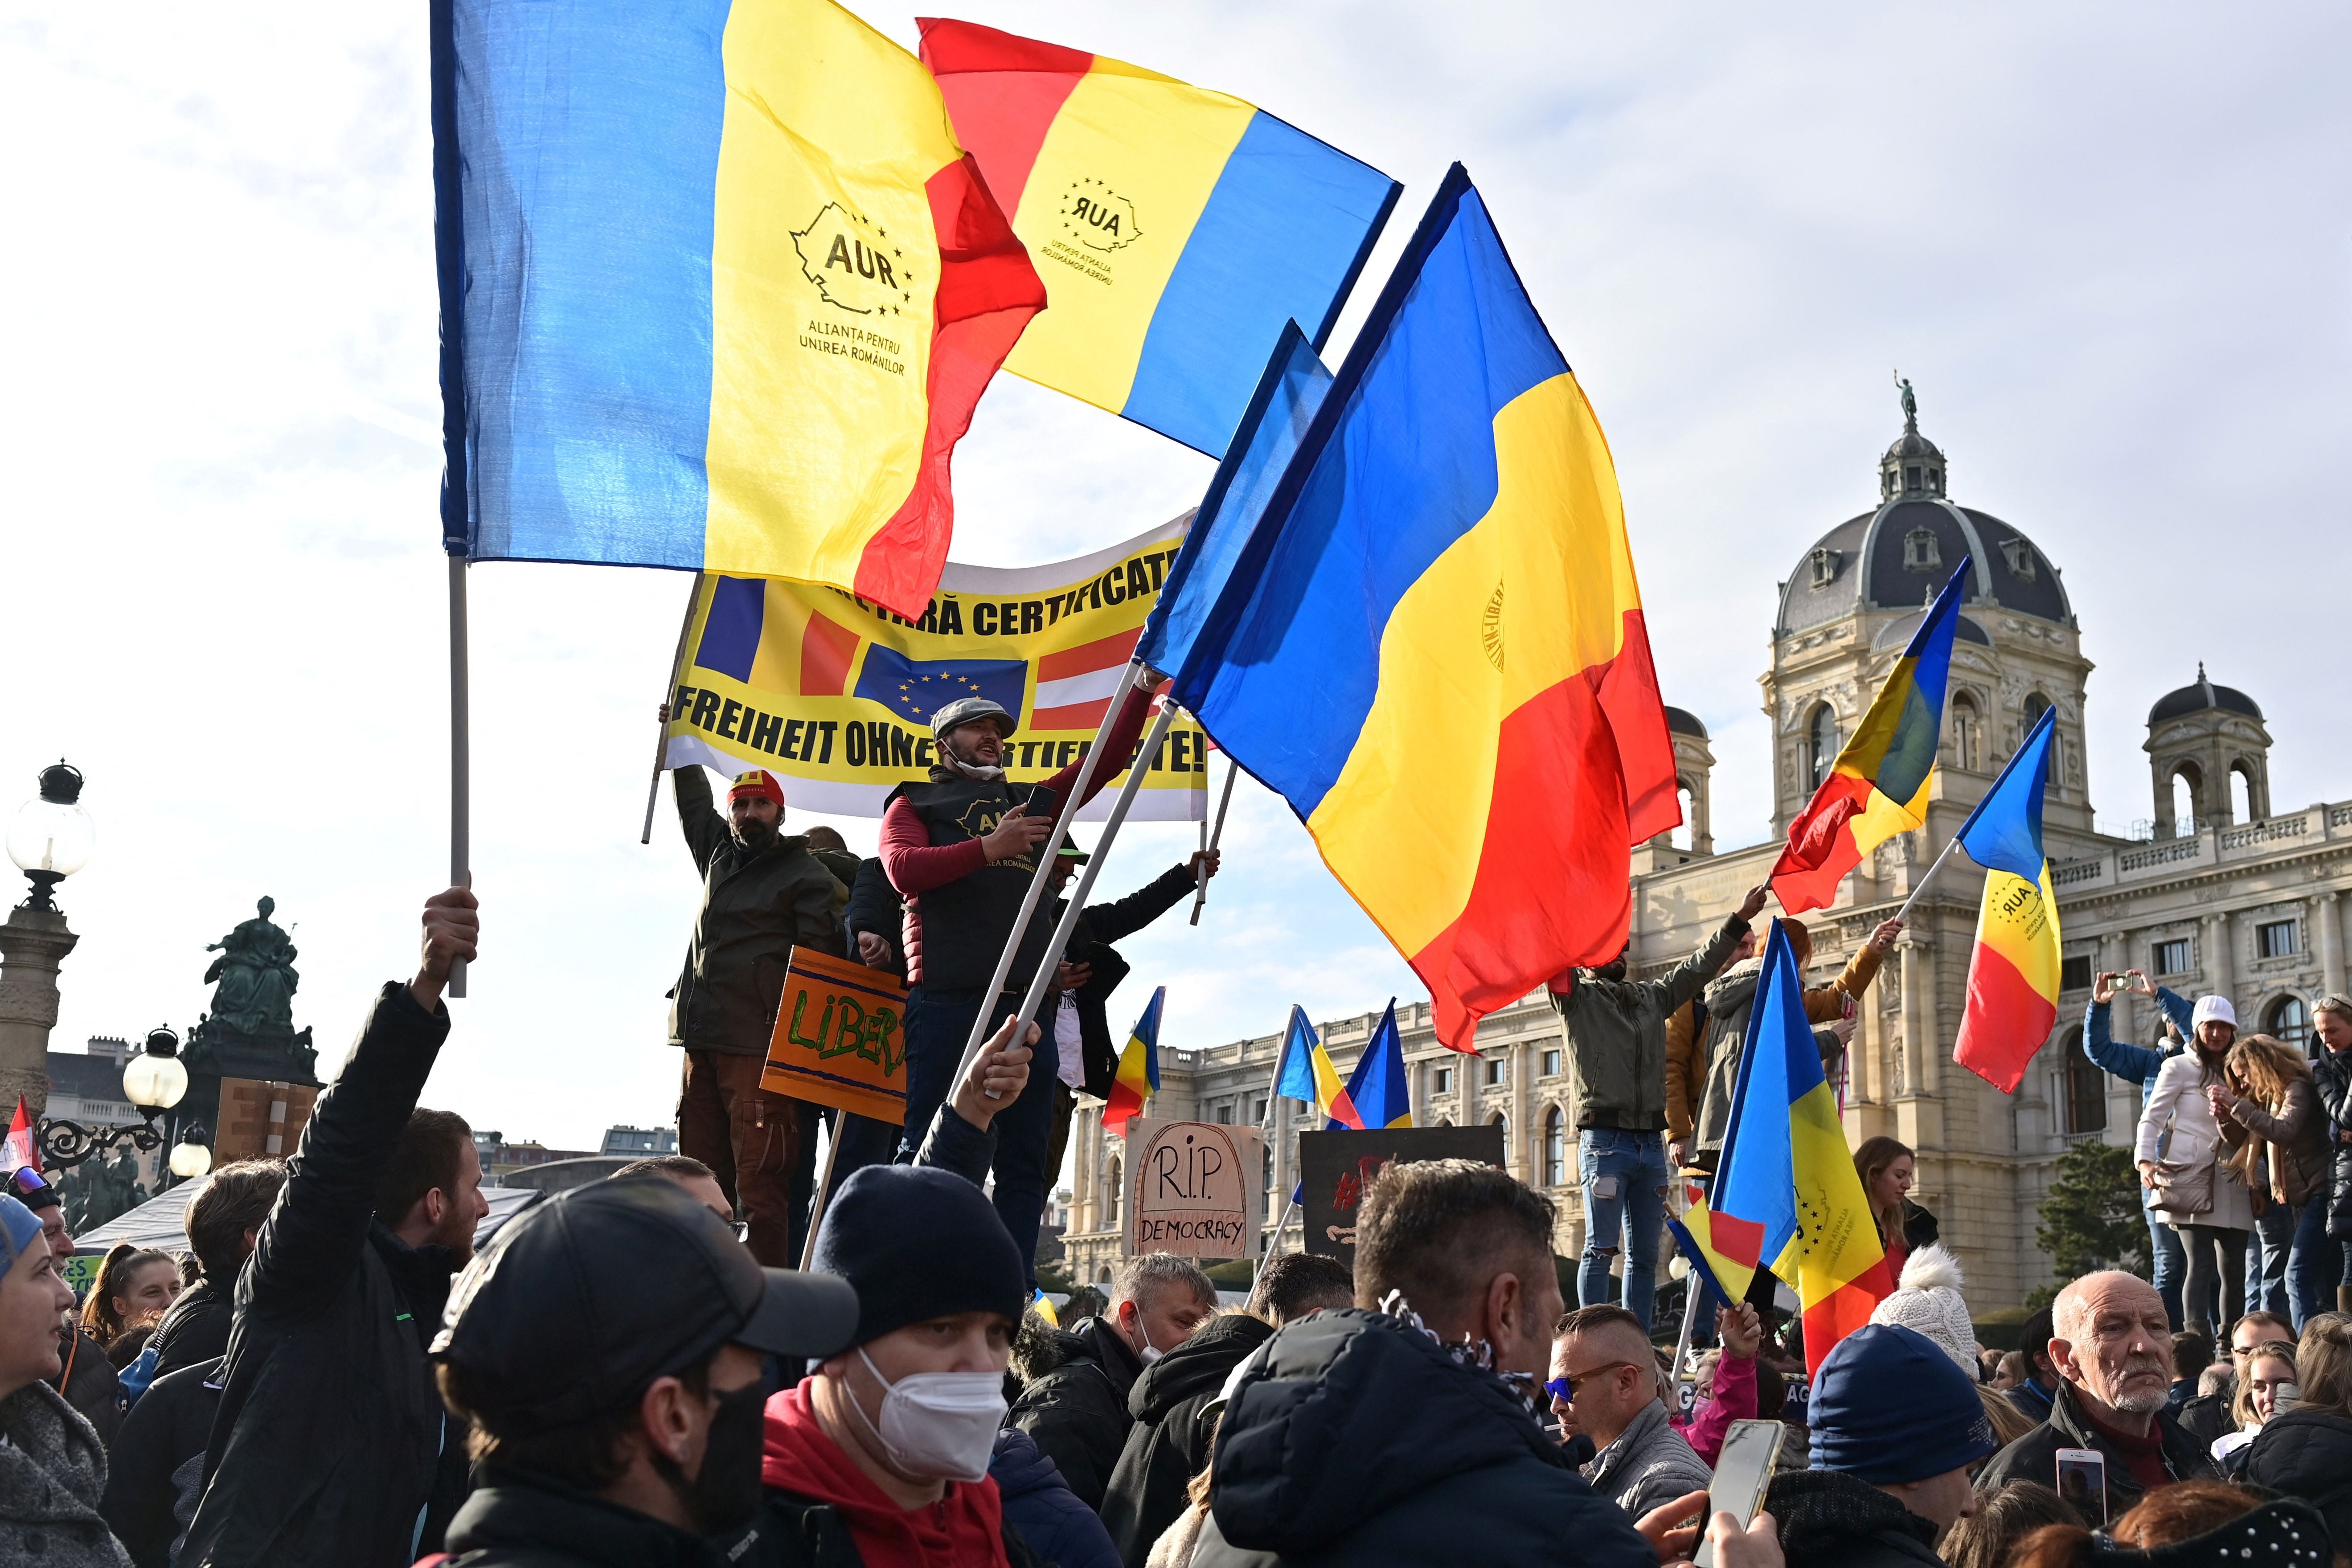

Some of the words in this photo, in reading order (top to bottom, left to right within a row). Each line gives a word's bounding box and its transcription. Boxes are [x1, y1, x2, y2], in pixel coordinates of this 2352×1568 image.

[825, 234, 898, 289] AUR
[799, 335, 848, 356] UNIREA
[851, 346, 904, 377] ROMÂNILOR
[809, 320, 864, 344] ALIANȚA
[866, 332, 901, 355] PENTRU
[672, 685, 838, 764] FREIHEIT
[846, 721, 934, 767] OHNE
[1141, 1219, 1243, 1245] DEMOCRACY
